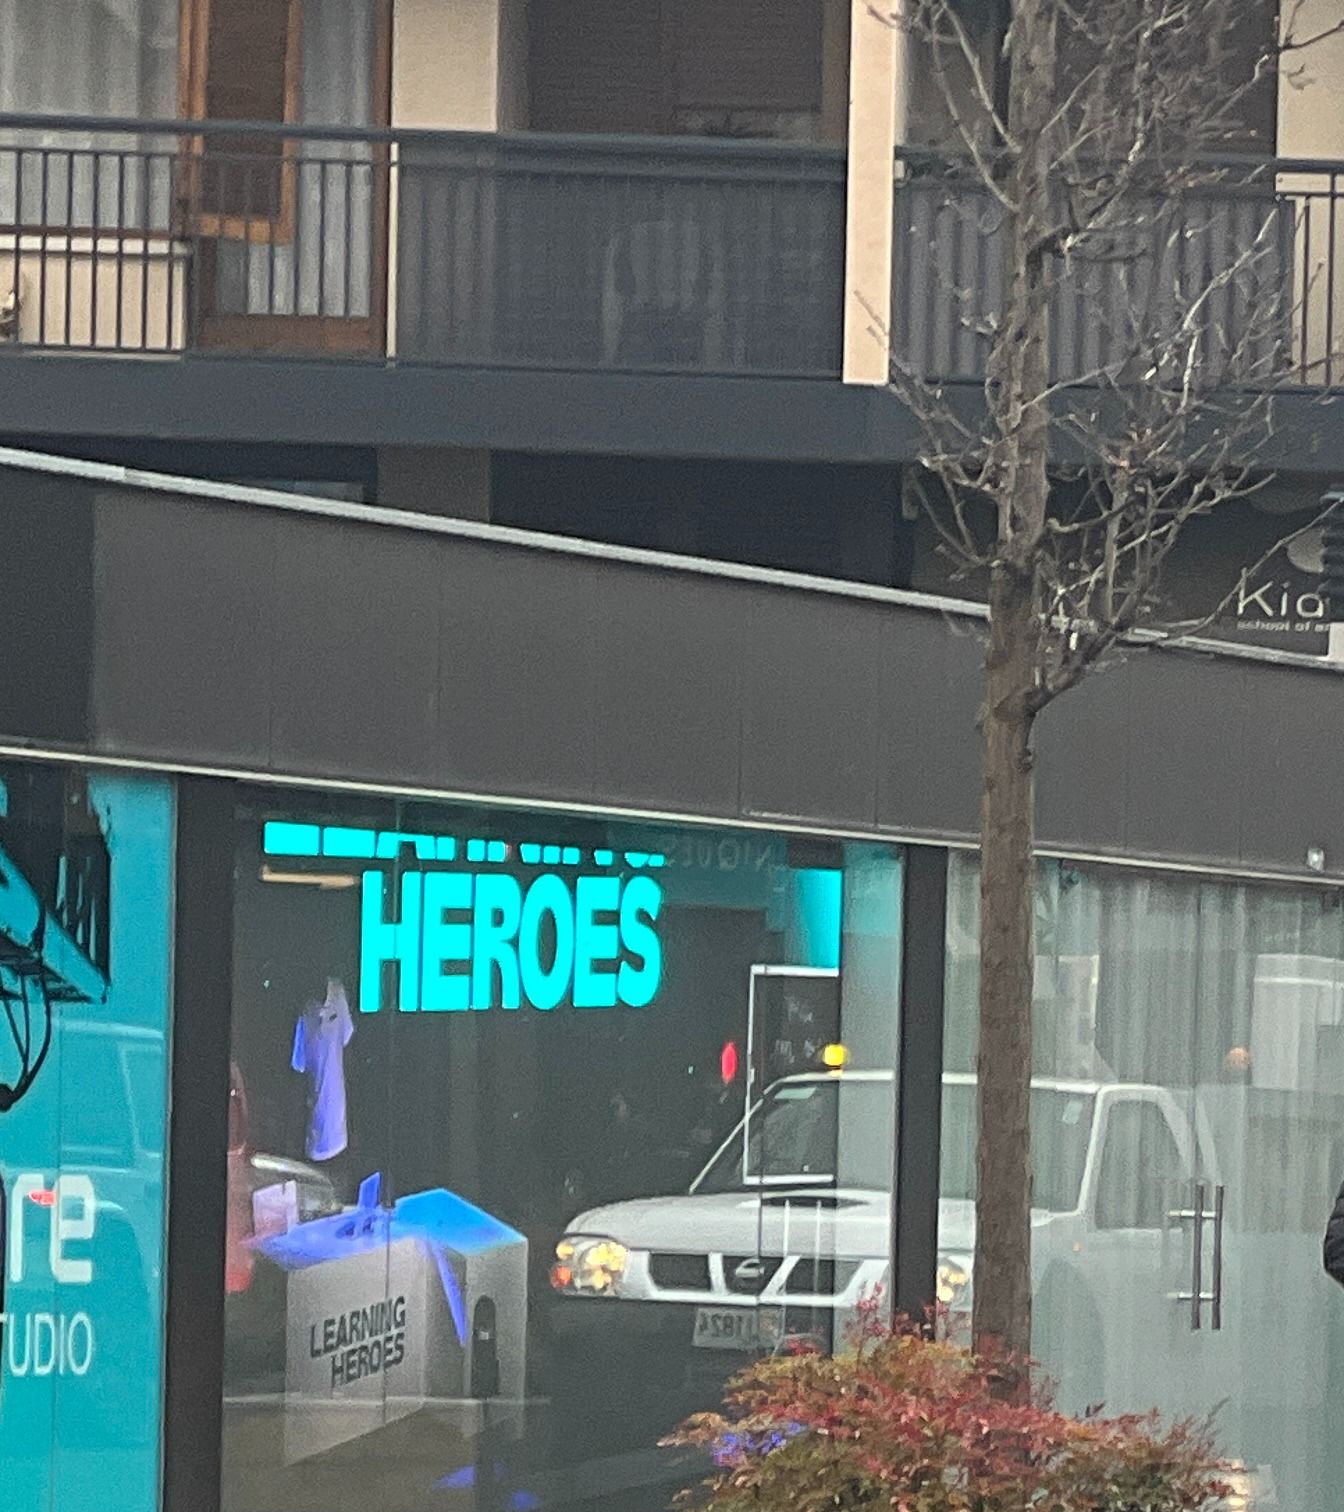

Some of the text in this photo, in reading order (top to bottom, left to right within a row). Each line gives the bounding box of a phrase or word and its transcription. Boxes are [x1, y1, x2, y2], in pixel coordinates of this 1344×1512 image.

[360, 869, 662, 1012] HEROES
[310, 1295, 406, 1358] LEARNING
[331, 1332, 405, 1389] HEROES
